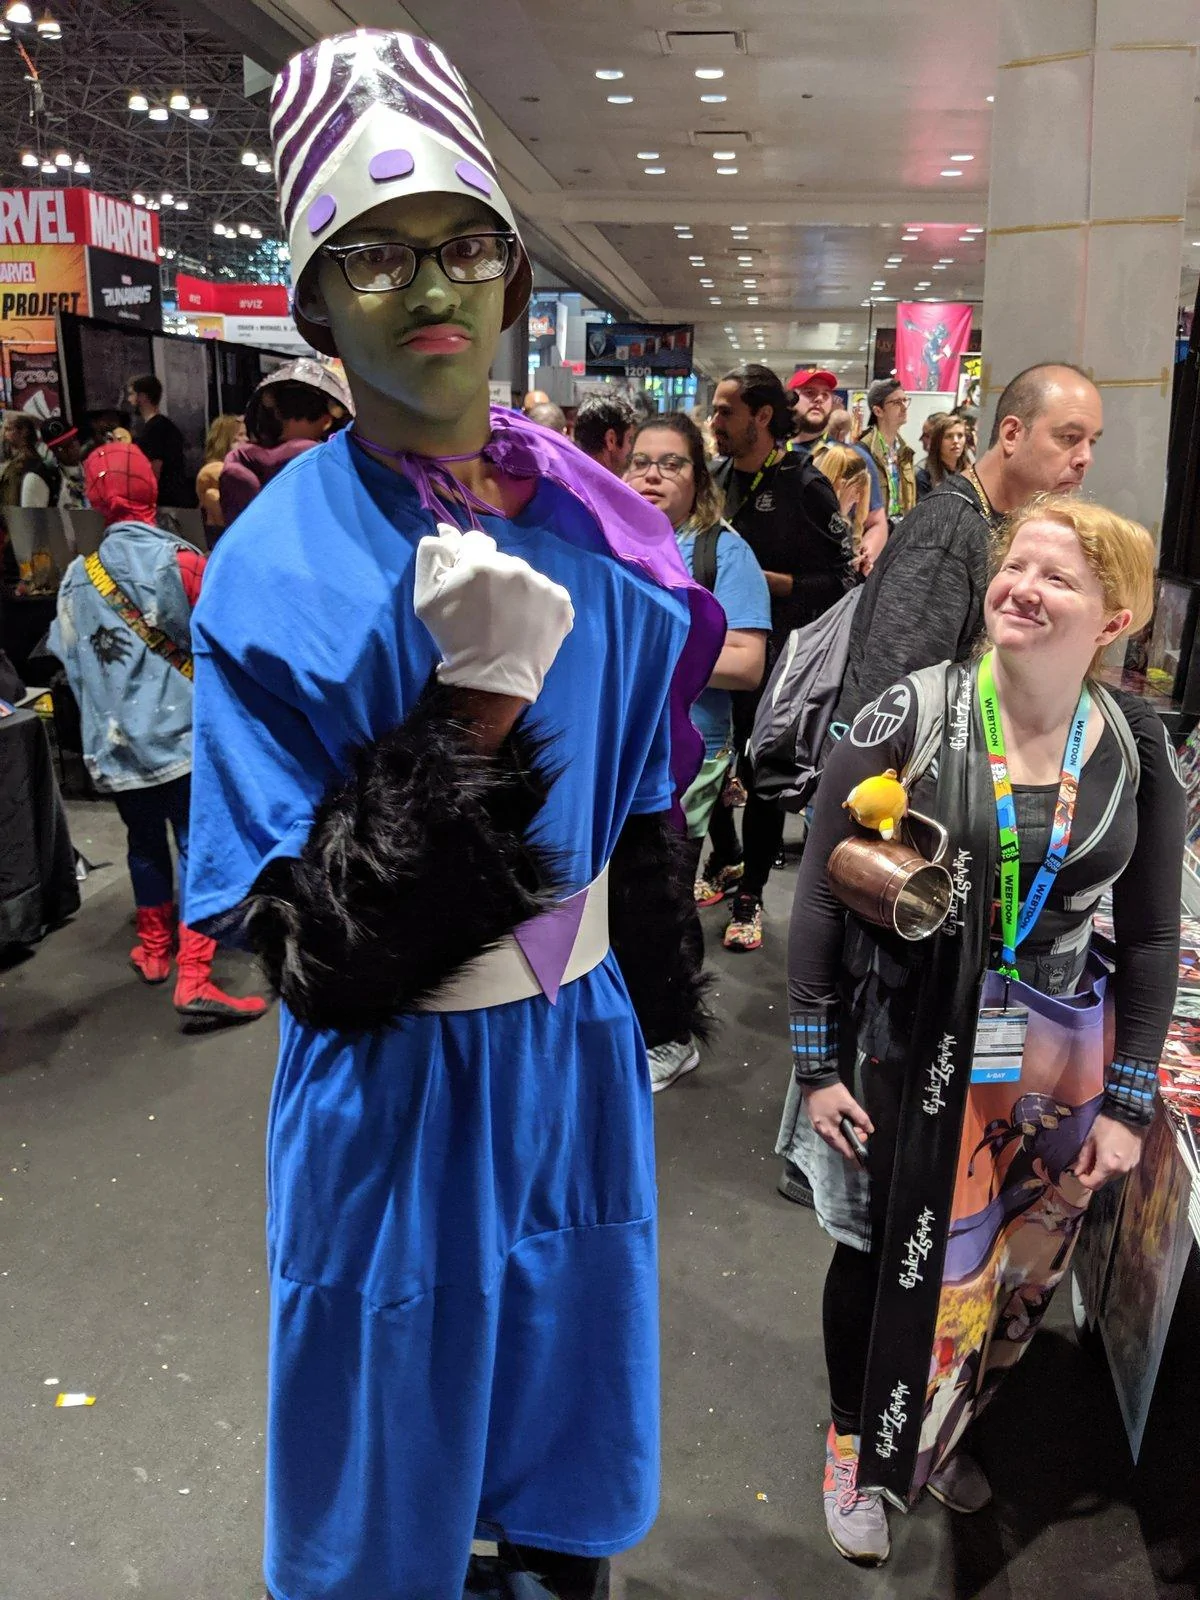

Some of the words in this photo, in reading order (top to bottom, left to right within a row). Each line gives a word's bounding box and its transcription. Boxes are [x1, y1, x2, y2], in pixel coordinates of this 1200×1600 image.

[88, 192, 157, 262] MARVEL
[2, 292, 81, 319] PROJECT
[624, 367, 652, 377] 1200
[984, 697, 998, 747] WEBTOON
[1070, 720, 1085, 766] WEBTOON
[1001, 846, 1016, 854] WEB
[1004, 875, 1014, 925] WEBTOON
[1020, 883, 1048, 929] WEBTOON
